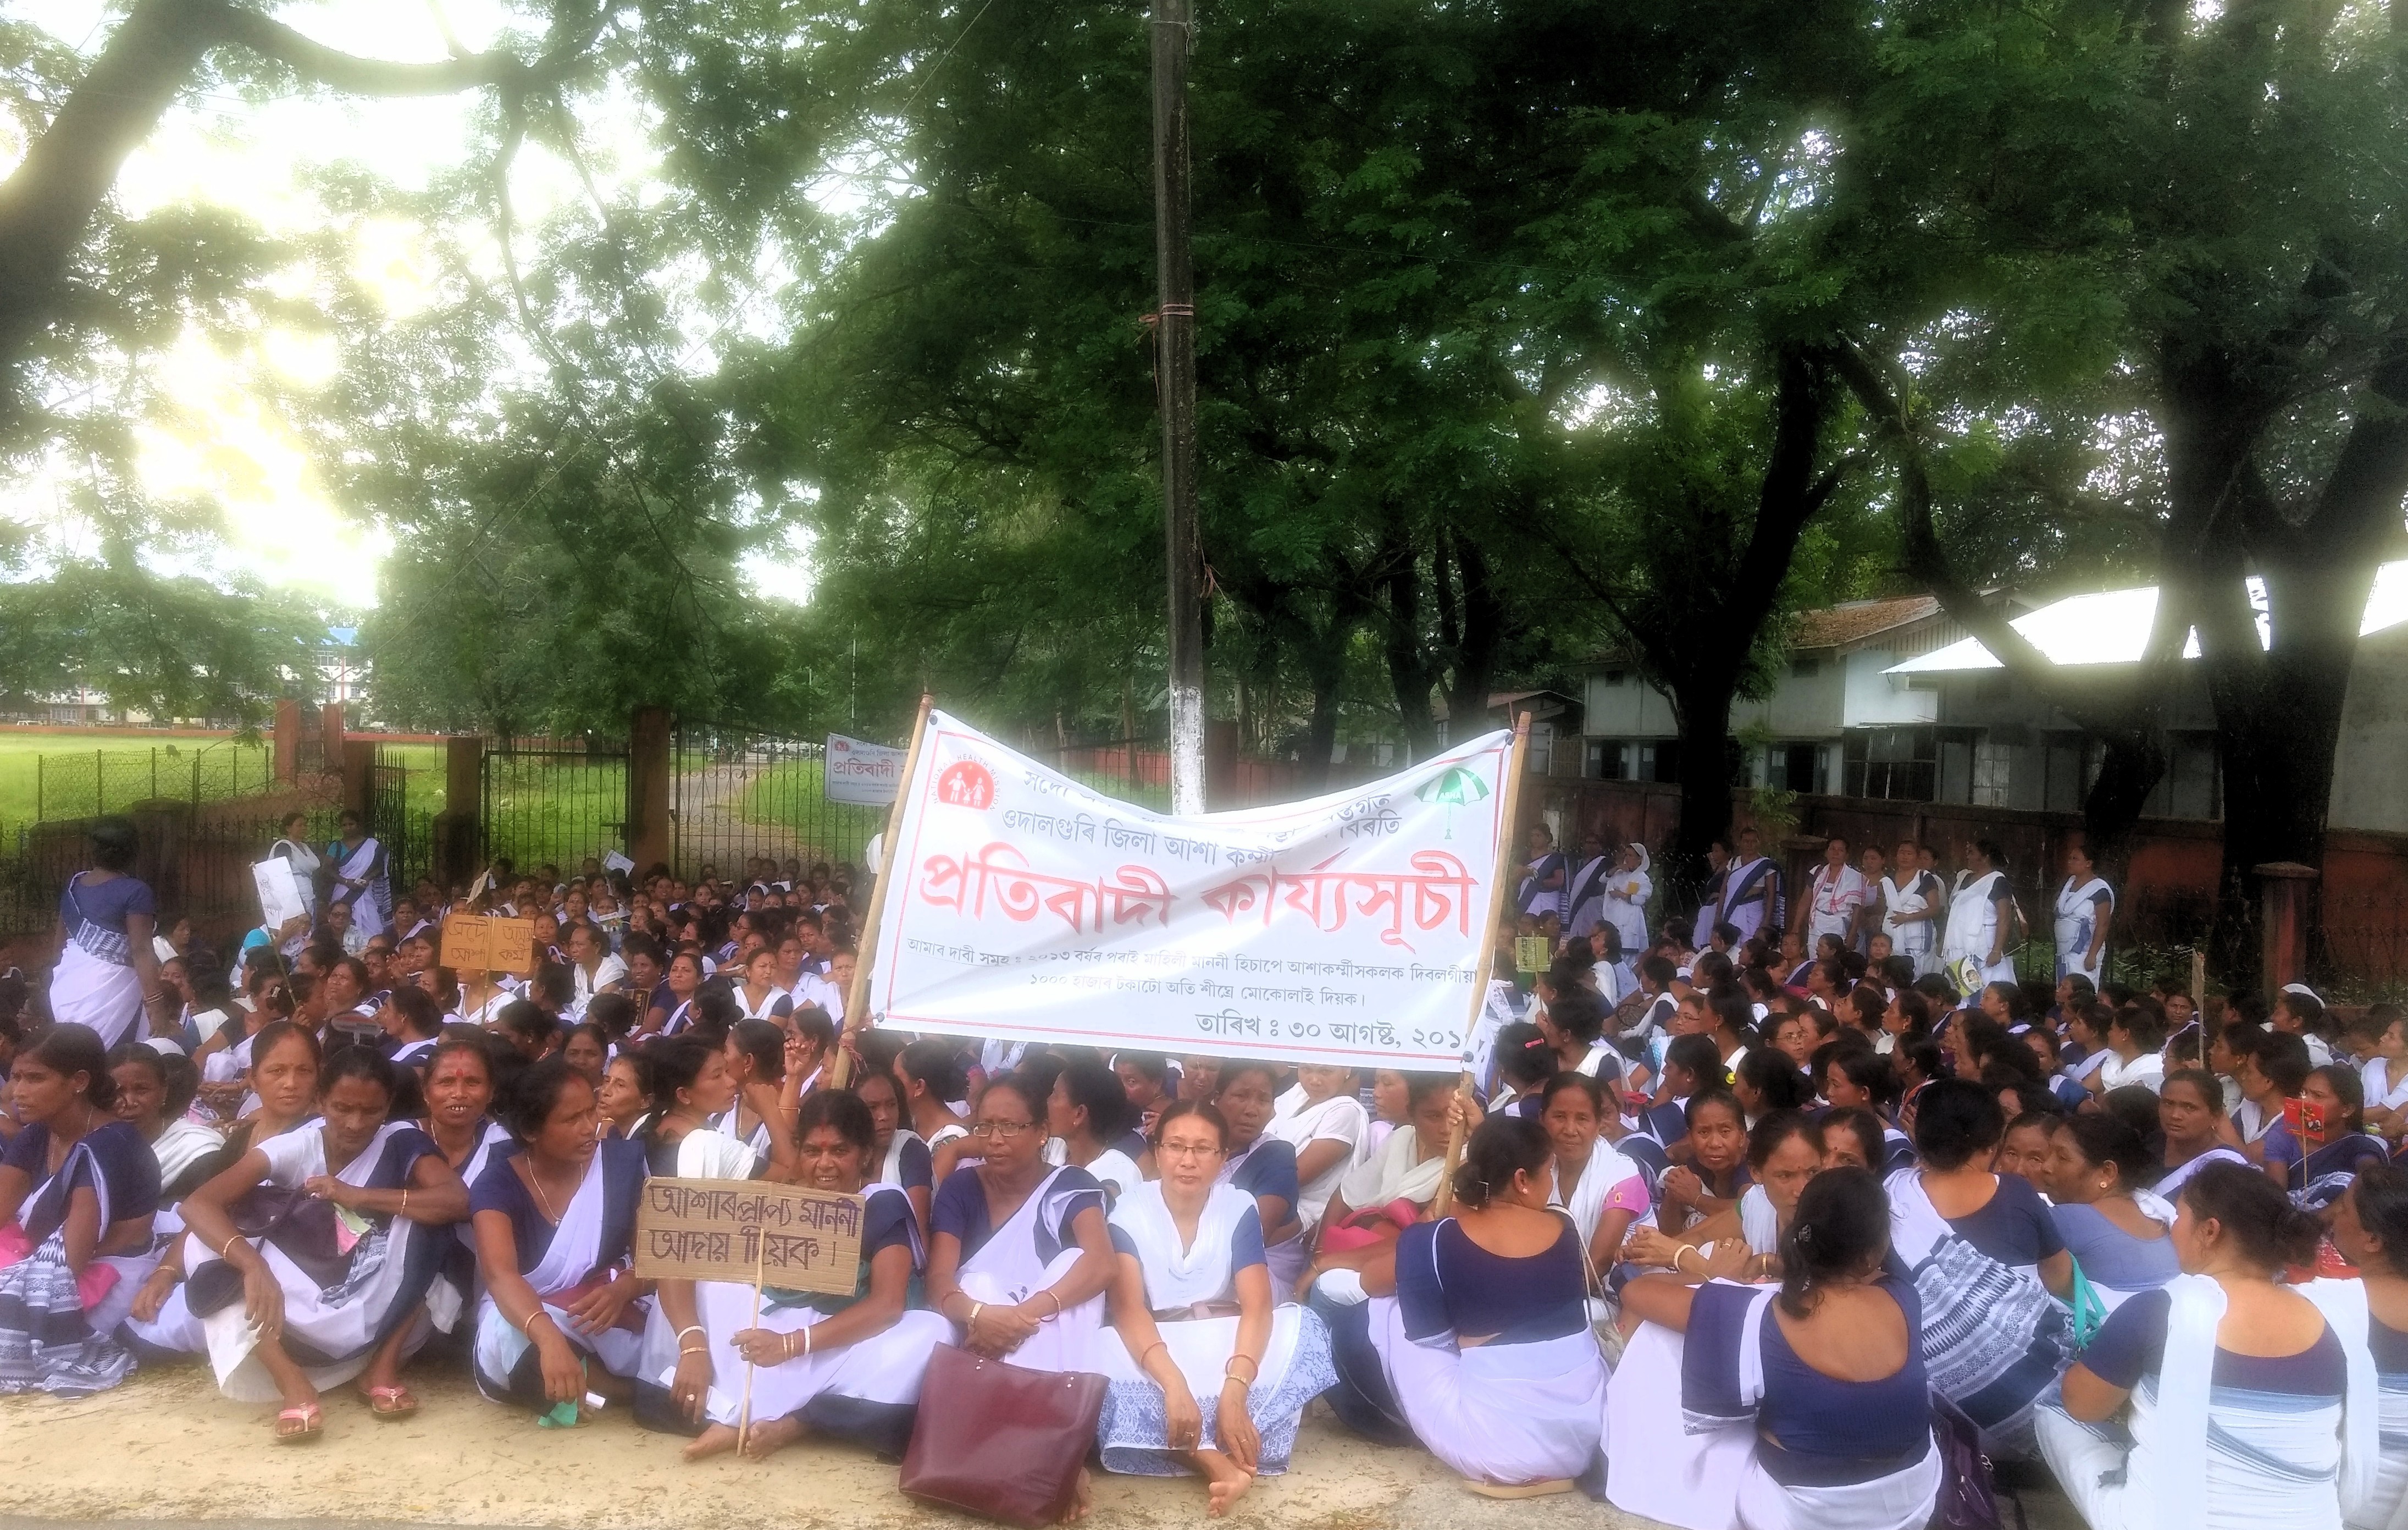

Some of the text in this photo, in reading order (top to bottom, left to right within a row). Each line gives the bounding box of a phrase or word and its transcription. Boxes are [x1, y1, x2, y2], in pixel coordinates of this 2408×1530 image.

[957, 753, 989, 768] HEALTH
[989, 769, 1001, 811] MISSION
[1001, 809, 1097, 844] ওদালগুৰি
[1103, 818, 1158, 855] জিলা
[1164, 836, 1219, 865] আশা
[451, 948, 485, 962] আশা
[949, 944, 975, 963] দাবী
[1192, 952, 1230, 970] মাননী
[1235, 953, 1283, 973] হিচাপে
[1030, 974, 1068, 984] ১০০০
[1165, 977, 1196, 995] অতি
[1194, 1008, 1262, 1037] তাৰিখ
[1288, 1021, 1321, 1038] ৩০
[1412, 1026, 1467, 1050] ২০১
